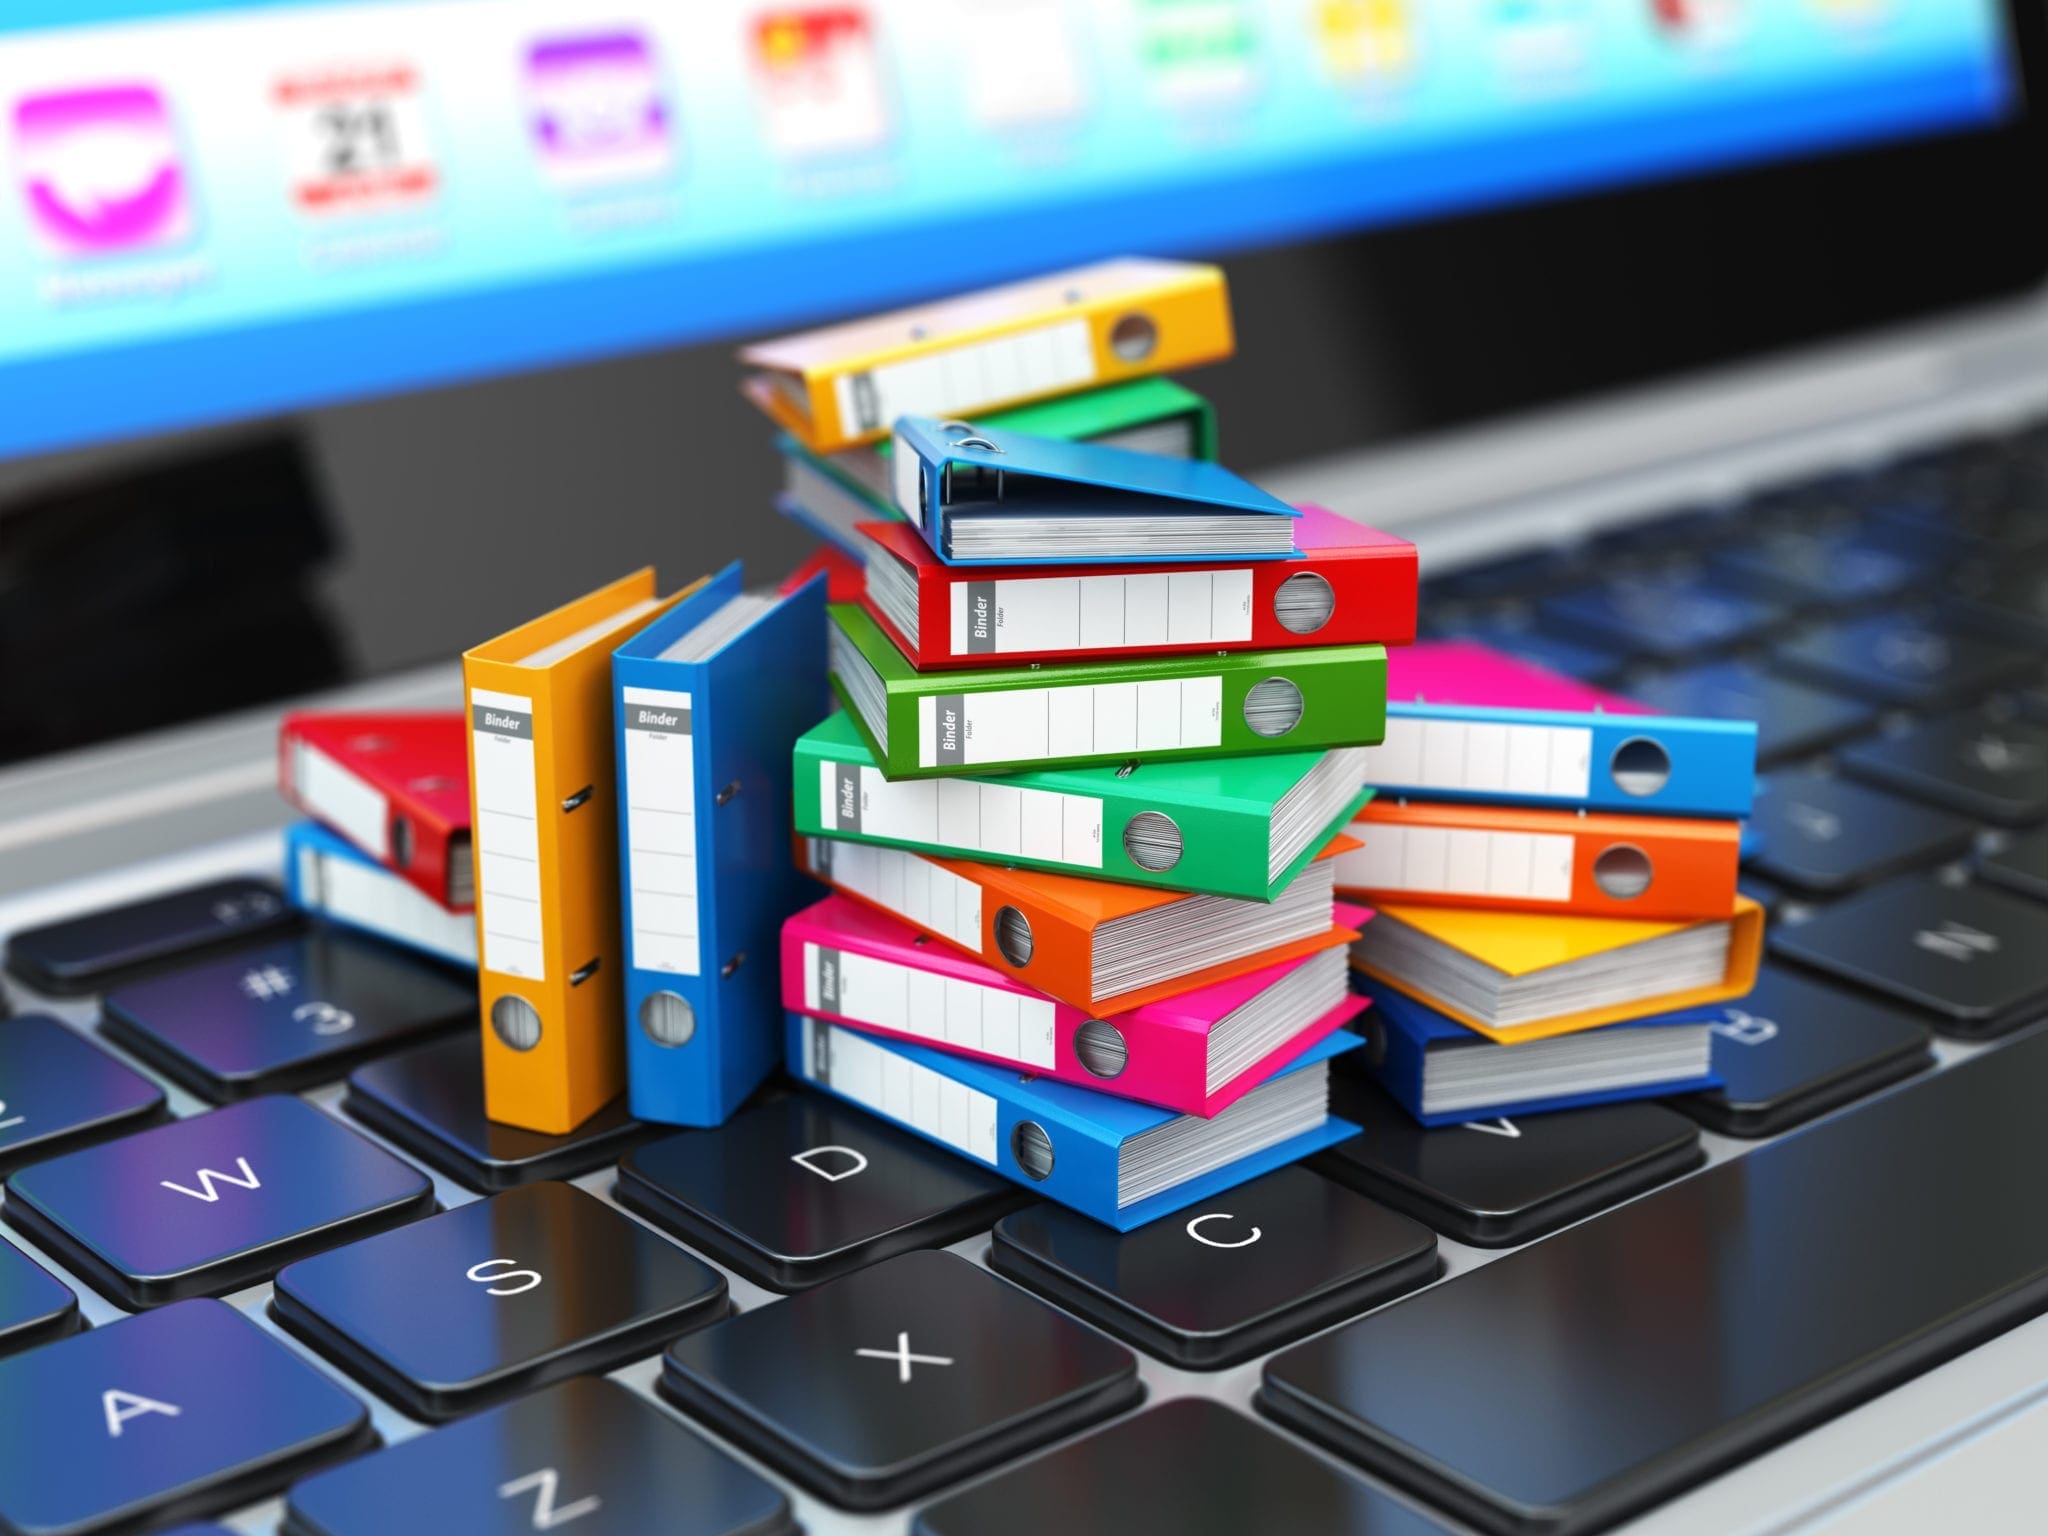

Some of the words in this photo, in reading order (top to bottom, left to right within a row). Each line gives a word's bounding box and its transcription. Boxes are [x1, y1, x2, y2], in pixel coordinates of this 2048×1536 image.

[973, 596, 987, 638] Binder
[484, 712, 520, 730] Binder
[638, 710, 678, 726] Binder
[942, 709, 956, 750] Binder
[840, 777, 854, 818] Binder
[291, 1000, 356, 1036] 3
[160, 1157, 261, 1203] W
[790, 1145, 868, 1182] D
[1186, 1213, 1262, 1248] C
[466, 1257, 542, 1297] S
[854, 1331, 954, 1383] X
[101, 1388, 181, 1438] A
[498, 1467, 601, 1530] Z
